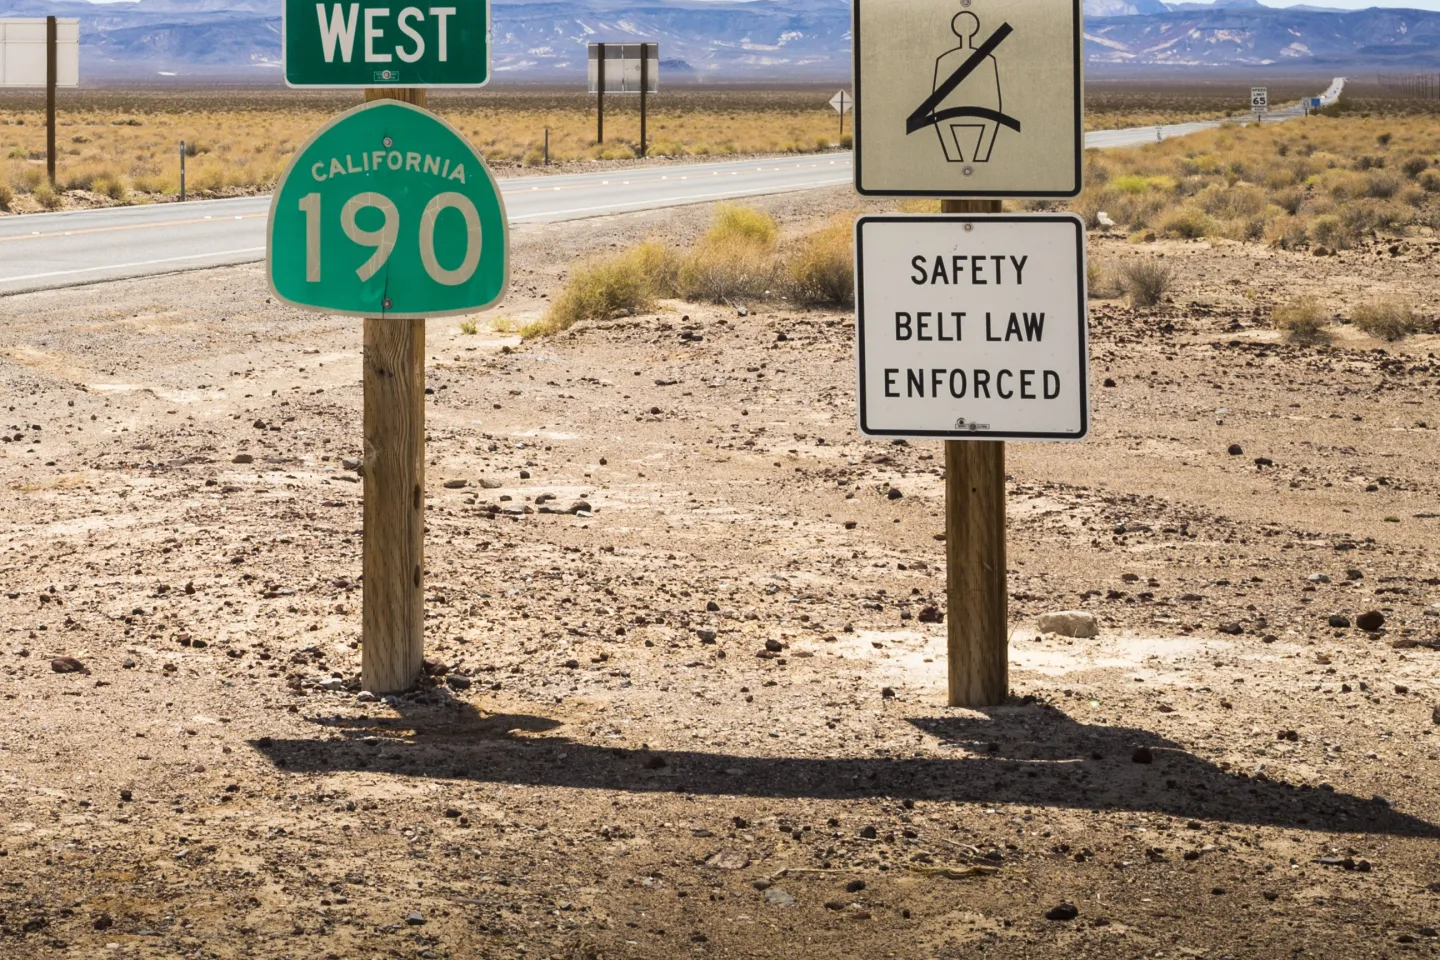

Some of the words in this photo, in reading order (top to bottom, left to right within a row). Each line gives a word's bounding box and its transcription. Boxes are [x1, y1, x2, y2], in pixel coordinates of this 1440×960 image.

[315, 2, 457, 63] WEST
[1253, 97, 1266, 105] 65
[311, 150, 466, 185] CALIFORNIA
[298, 191, 483, 286] 190
[910, 254, 1028, 286] SAFETY
[895, 311, 967, 342] BELT
[985, 312, 1046, 342] LAW
[884, 368, 1061, 400] ENFORCED
